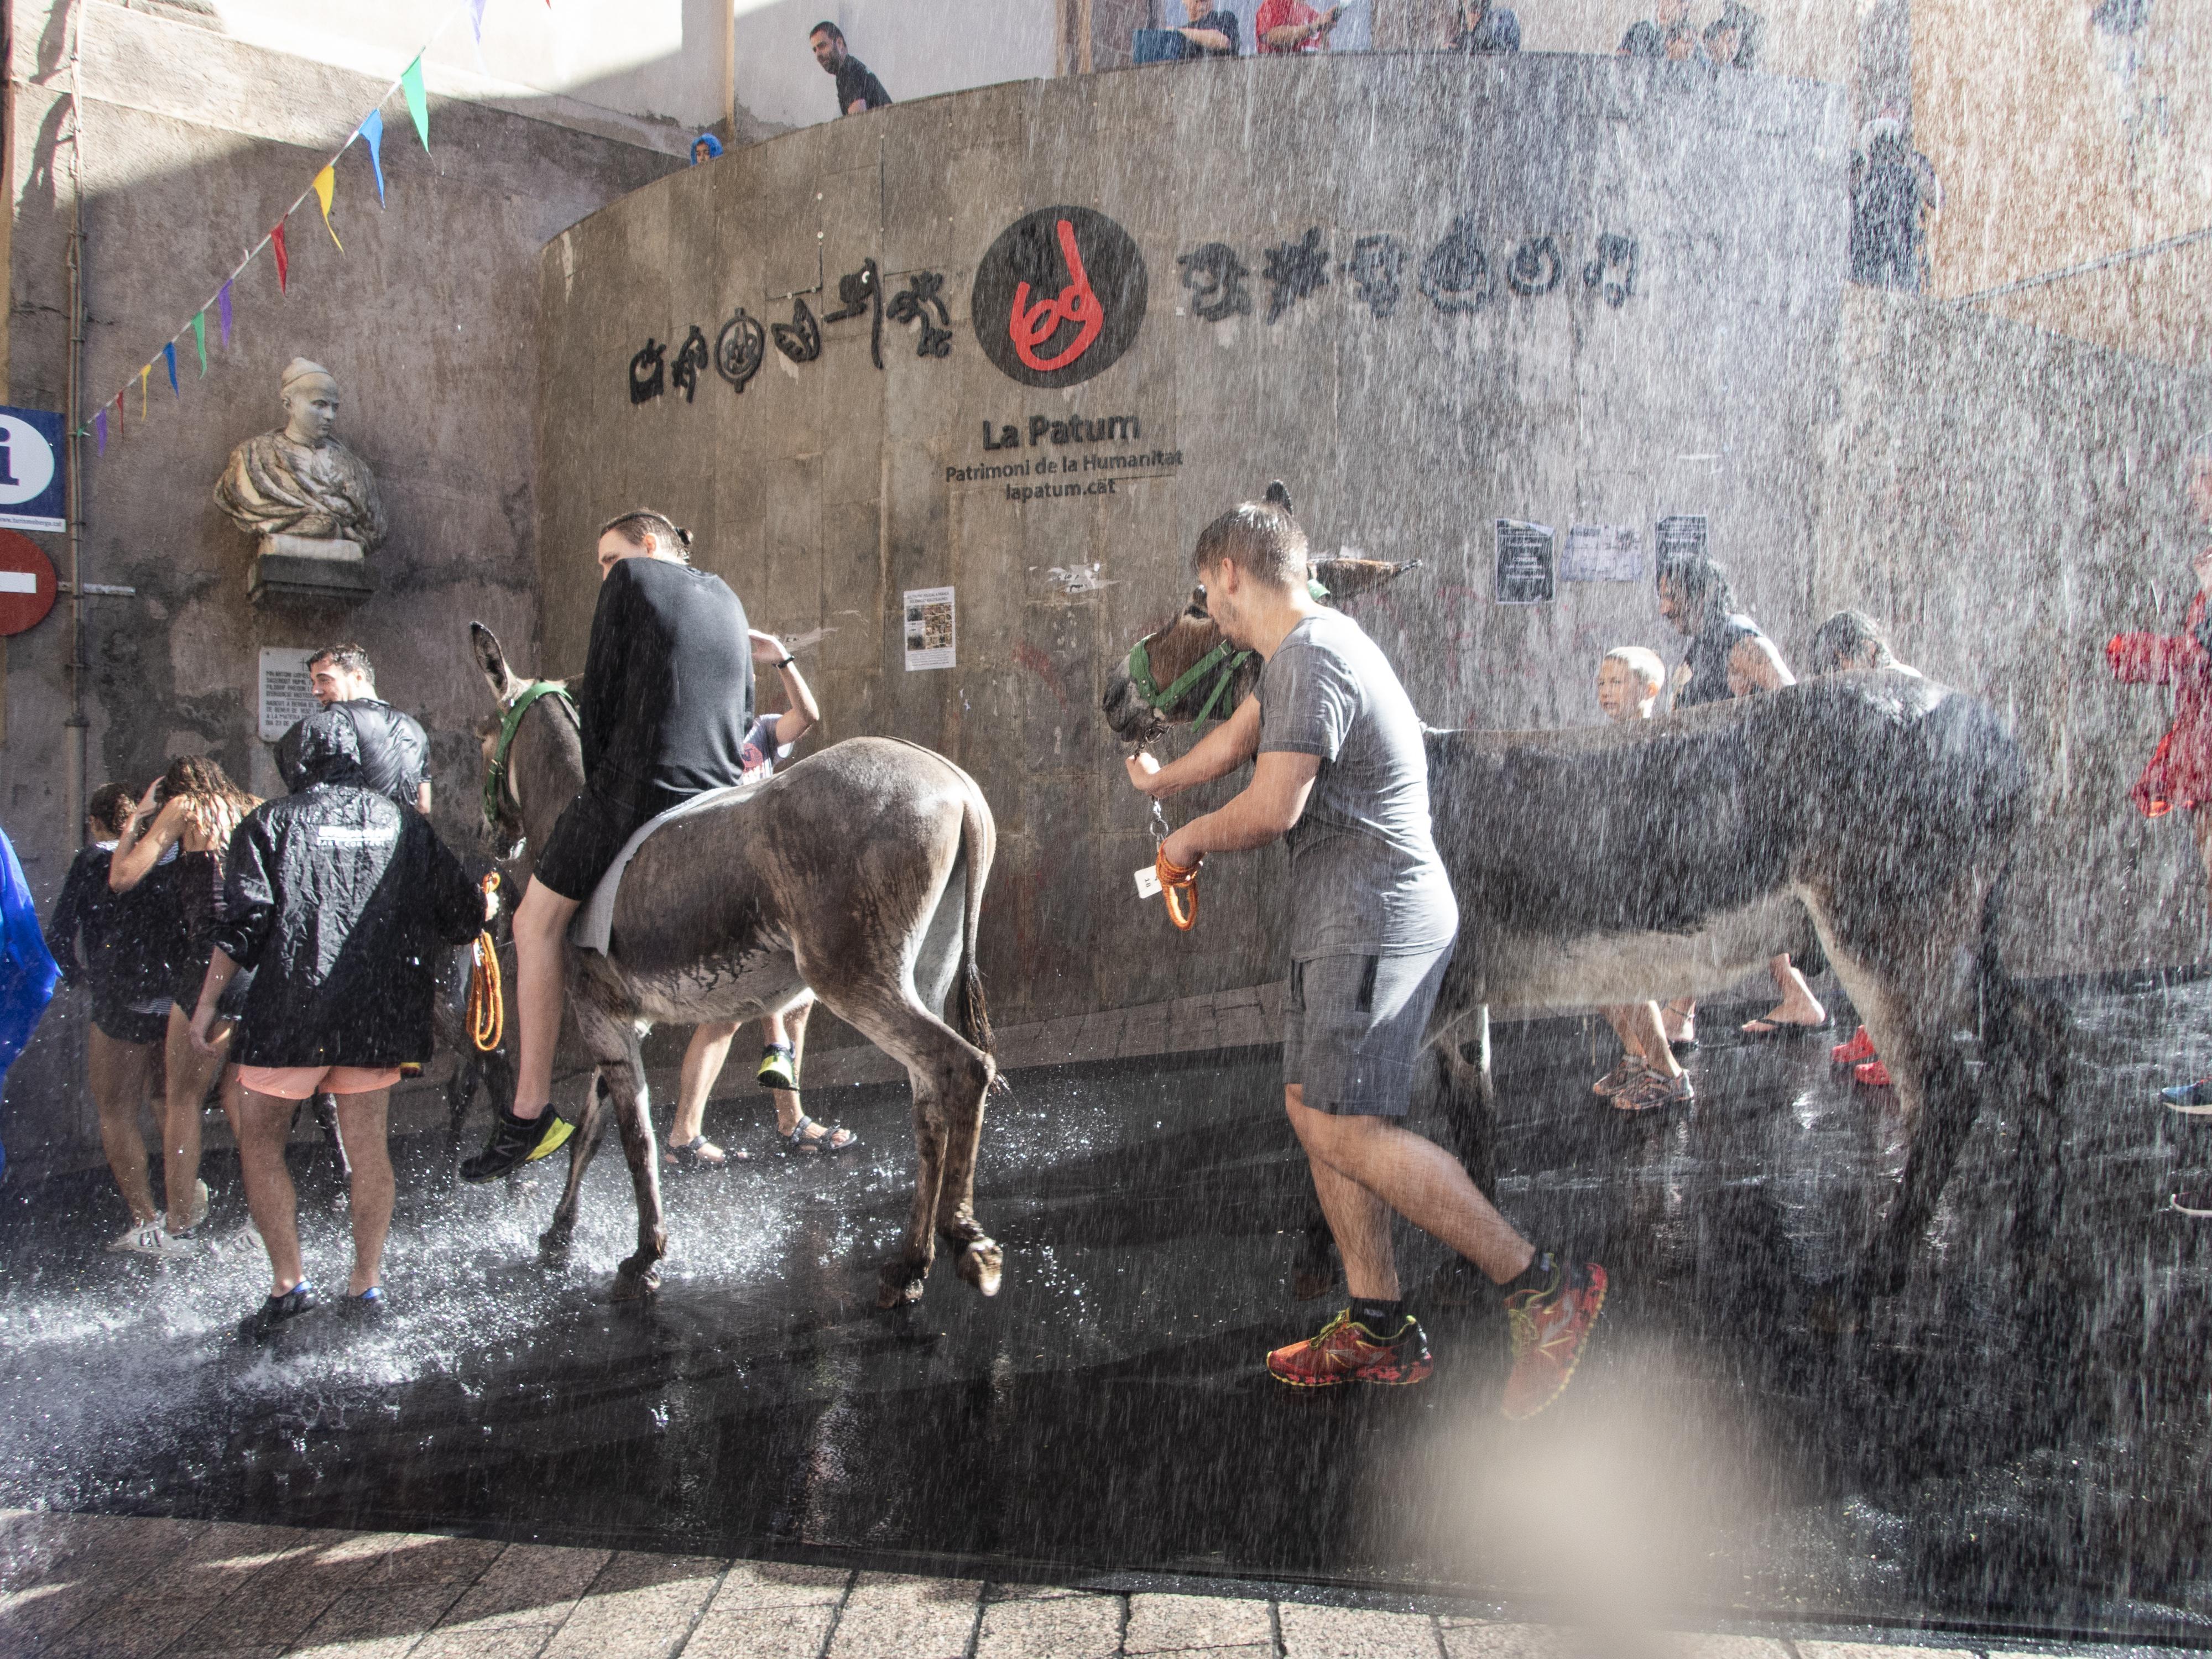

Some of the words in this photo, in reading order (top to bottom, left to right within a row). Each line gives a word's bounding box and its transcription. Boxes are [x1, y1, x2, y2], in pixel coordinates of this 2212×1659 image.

[982, 420, 1020, 451] La
[1029, 414, 1141, 447] Patum
[946, 458, 1031, 483] Patrimoni
[1035, 456, 1058, 474] de
[1061, 455, 1079, 473] la
[1082, 448, 1184, 471] Humanitat
[1005, 479, 1116, 503] lapatum.cat
